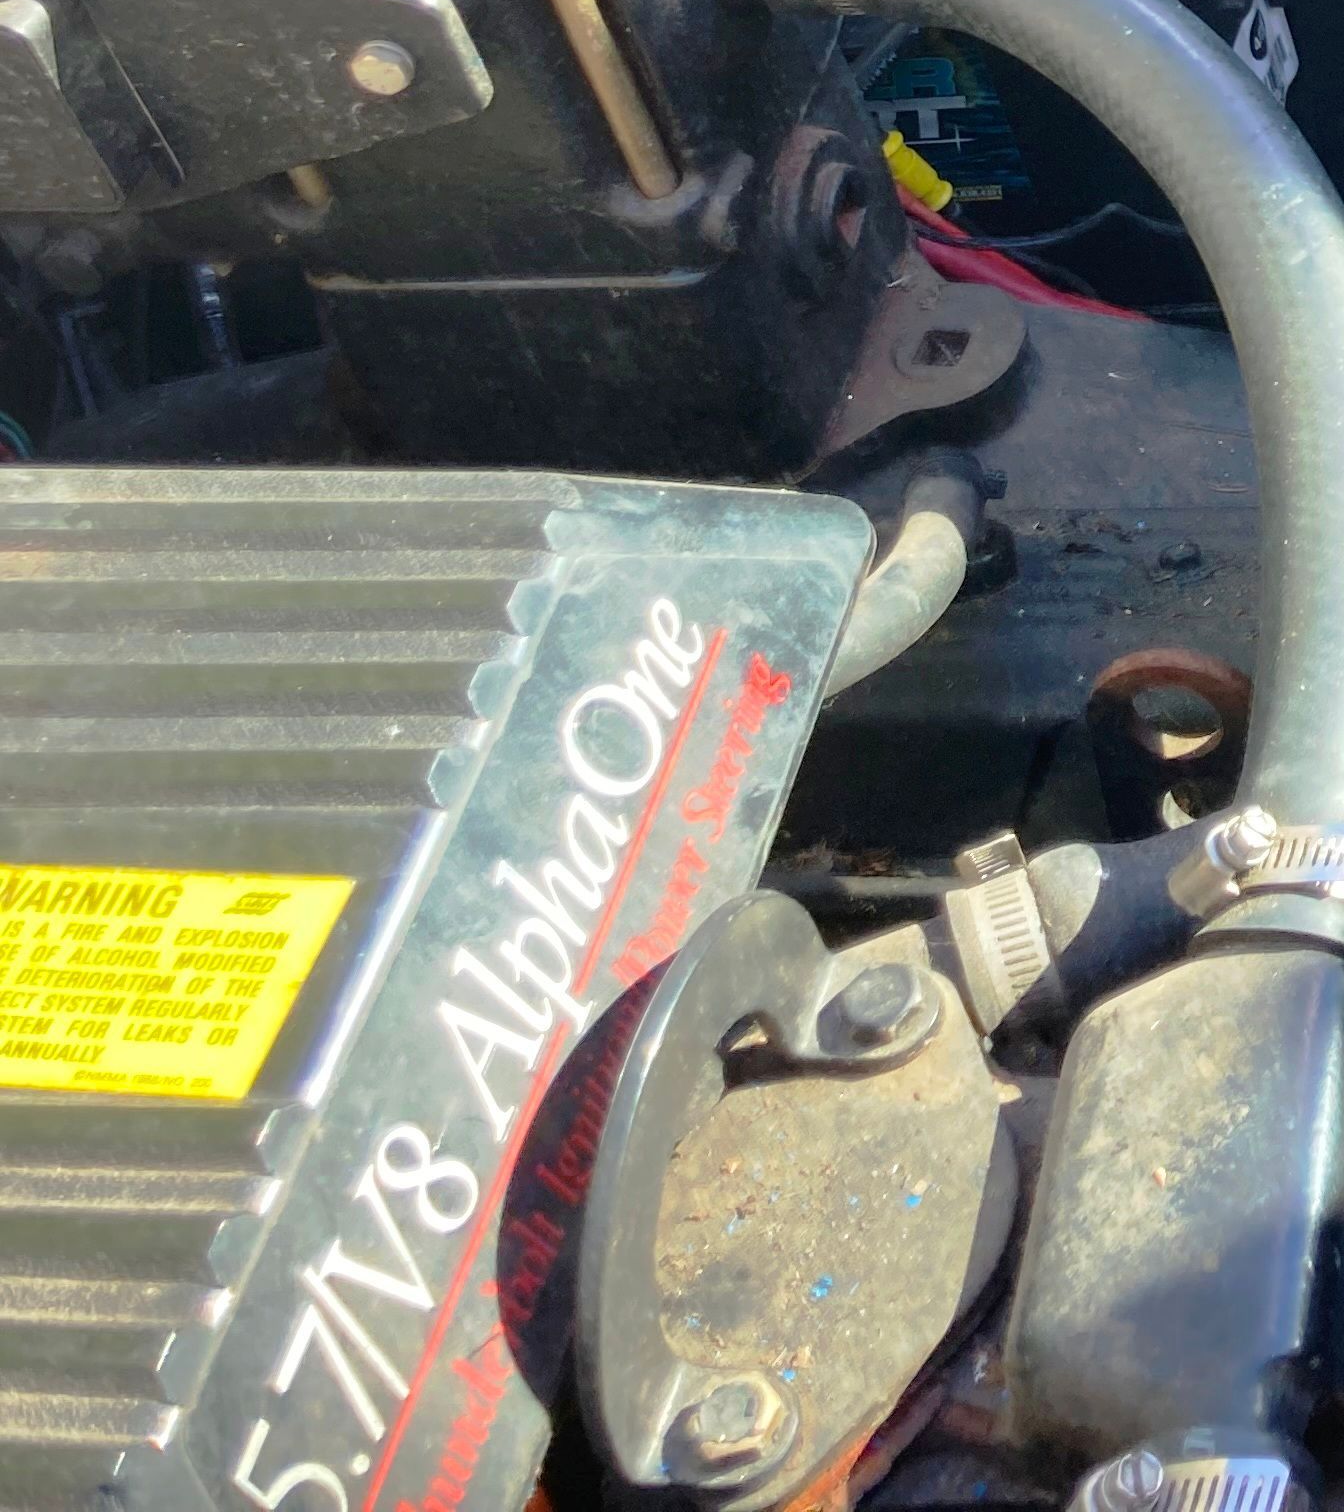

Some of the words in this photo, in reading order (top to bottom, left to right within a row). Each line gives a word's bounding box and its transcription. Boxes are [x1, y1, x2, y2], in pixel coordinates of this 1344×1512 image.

[0, 878, 183, 918] WARNING
[2, 921, 25, 937] IS
[34, 923, 47, 937] A
[62, 923, 108, 940] FIRE
[118, 926, 162, 945] AND
[174, 928, 289, 949] EXPLOSION
[30, 946, 60, 962] OF
[69, 949, 161, 969] ALCOHOL
[173, 952, 276, 973] MODIFIED
[16, 968, 176, 994] DETERIORATION
[186, 976, 216, 994] OF
[225, 979, 265, 997] THE
[41, 994, 125, 1015] SYSTEM
[129, 998, 249, 1021] REGULARLY
[67, 1020, 109, 1038] FOR
[123, 1024, 193, 1045] LEAKS
[207, 1028, 239, 1047] OR
[0, 1042, 105, 1064] ANNUALLY
